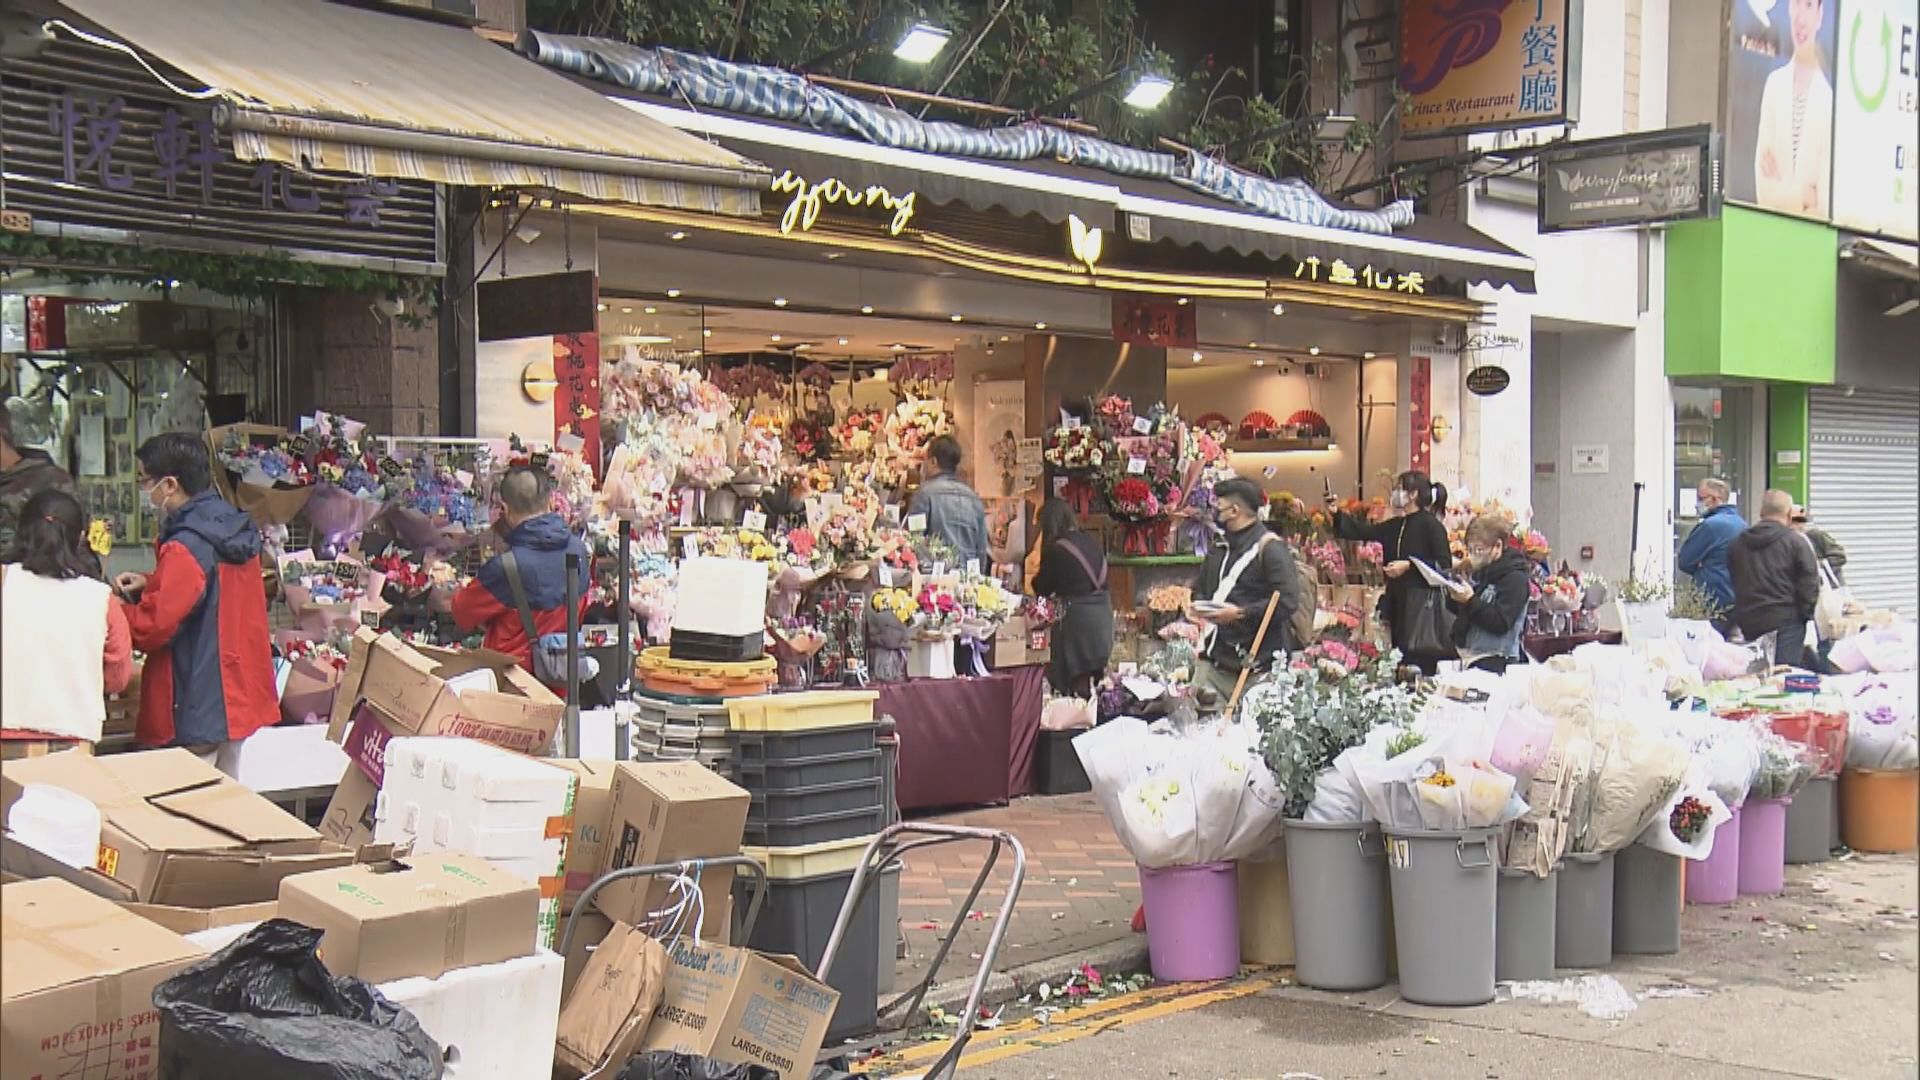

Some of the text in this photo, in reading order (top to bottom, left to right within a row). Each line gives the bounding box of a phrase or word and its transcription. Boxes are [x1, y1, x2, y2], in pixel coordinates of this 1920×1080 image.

[1900, 24, 1919, 78] E
[1445, 92, 1515, 112] Restaurant
[40, 1034, 60, 1051] CM
[731, 1035, 793, 1073] LARGE (63888)
